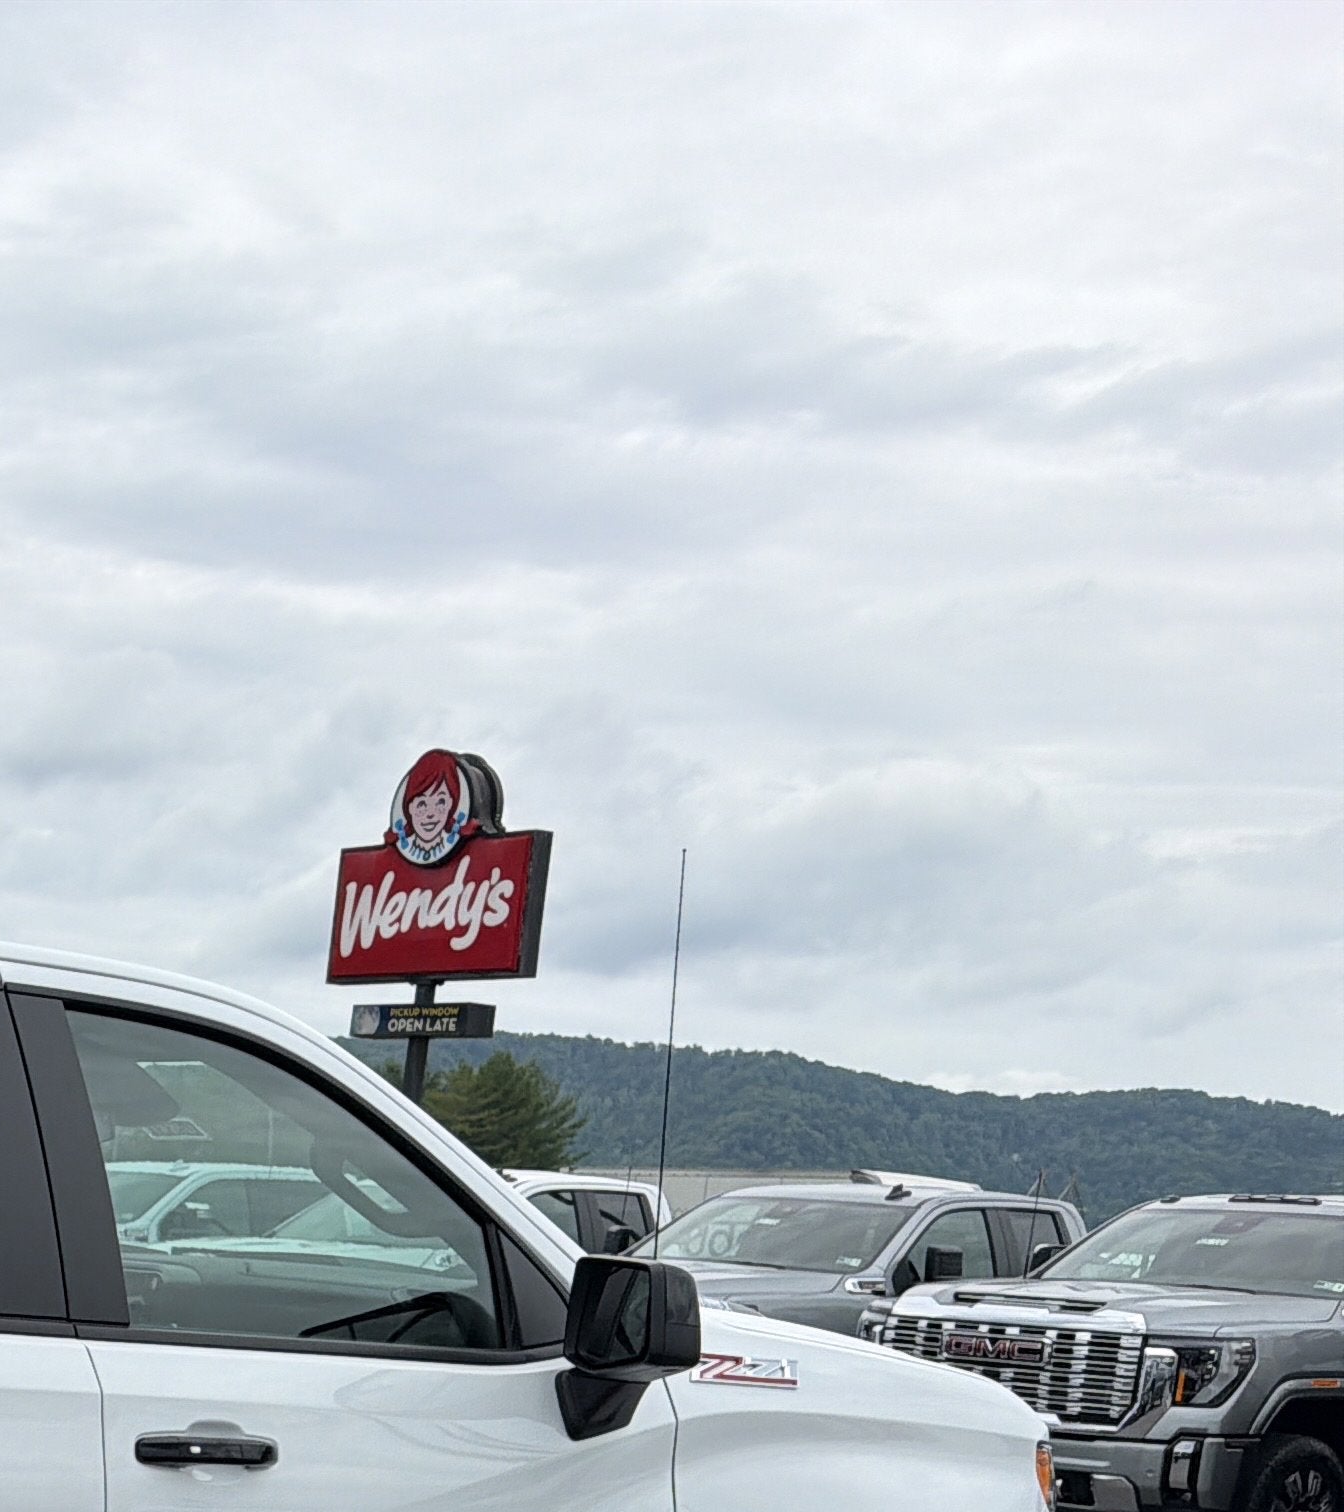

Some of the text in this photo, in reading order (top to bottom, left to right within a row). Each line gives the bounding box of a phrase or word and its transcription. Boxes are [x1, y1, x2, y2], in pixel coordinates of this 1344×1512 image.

[340, 855, 514, 958] Wendy's
[390, 1006, 460, 1017] PICKUP WINDOW
[387, 1017, 458, 1032] OPEN LATE
[945, 1335, 1044, 1361] GMC
